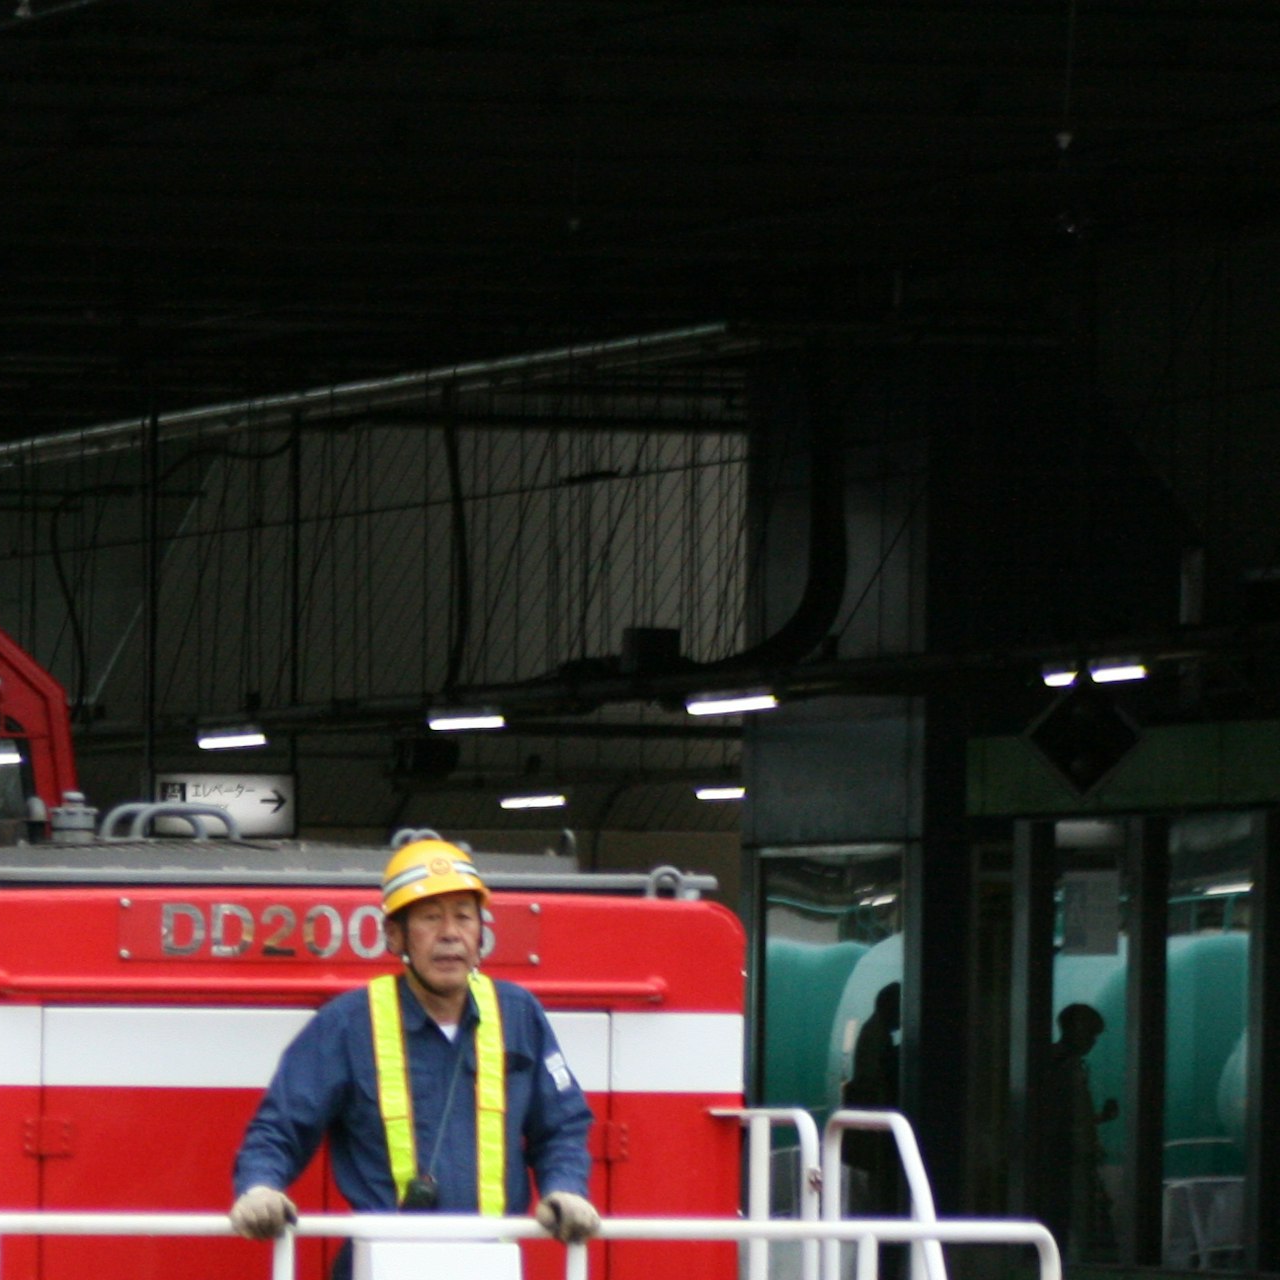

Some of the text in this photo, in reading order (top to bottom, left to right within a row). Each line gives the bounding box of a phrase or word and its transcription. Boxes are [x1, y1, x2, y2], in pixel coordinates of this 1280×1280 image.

[191, 783, 256, 798] エレベーター
[161, 903, 496, 959] DD200
